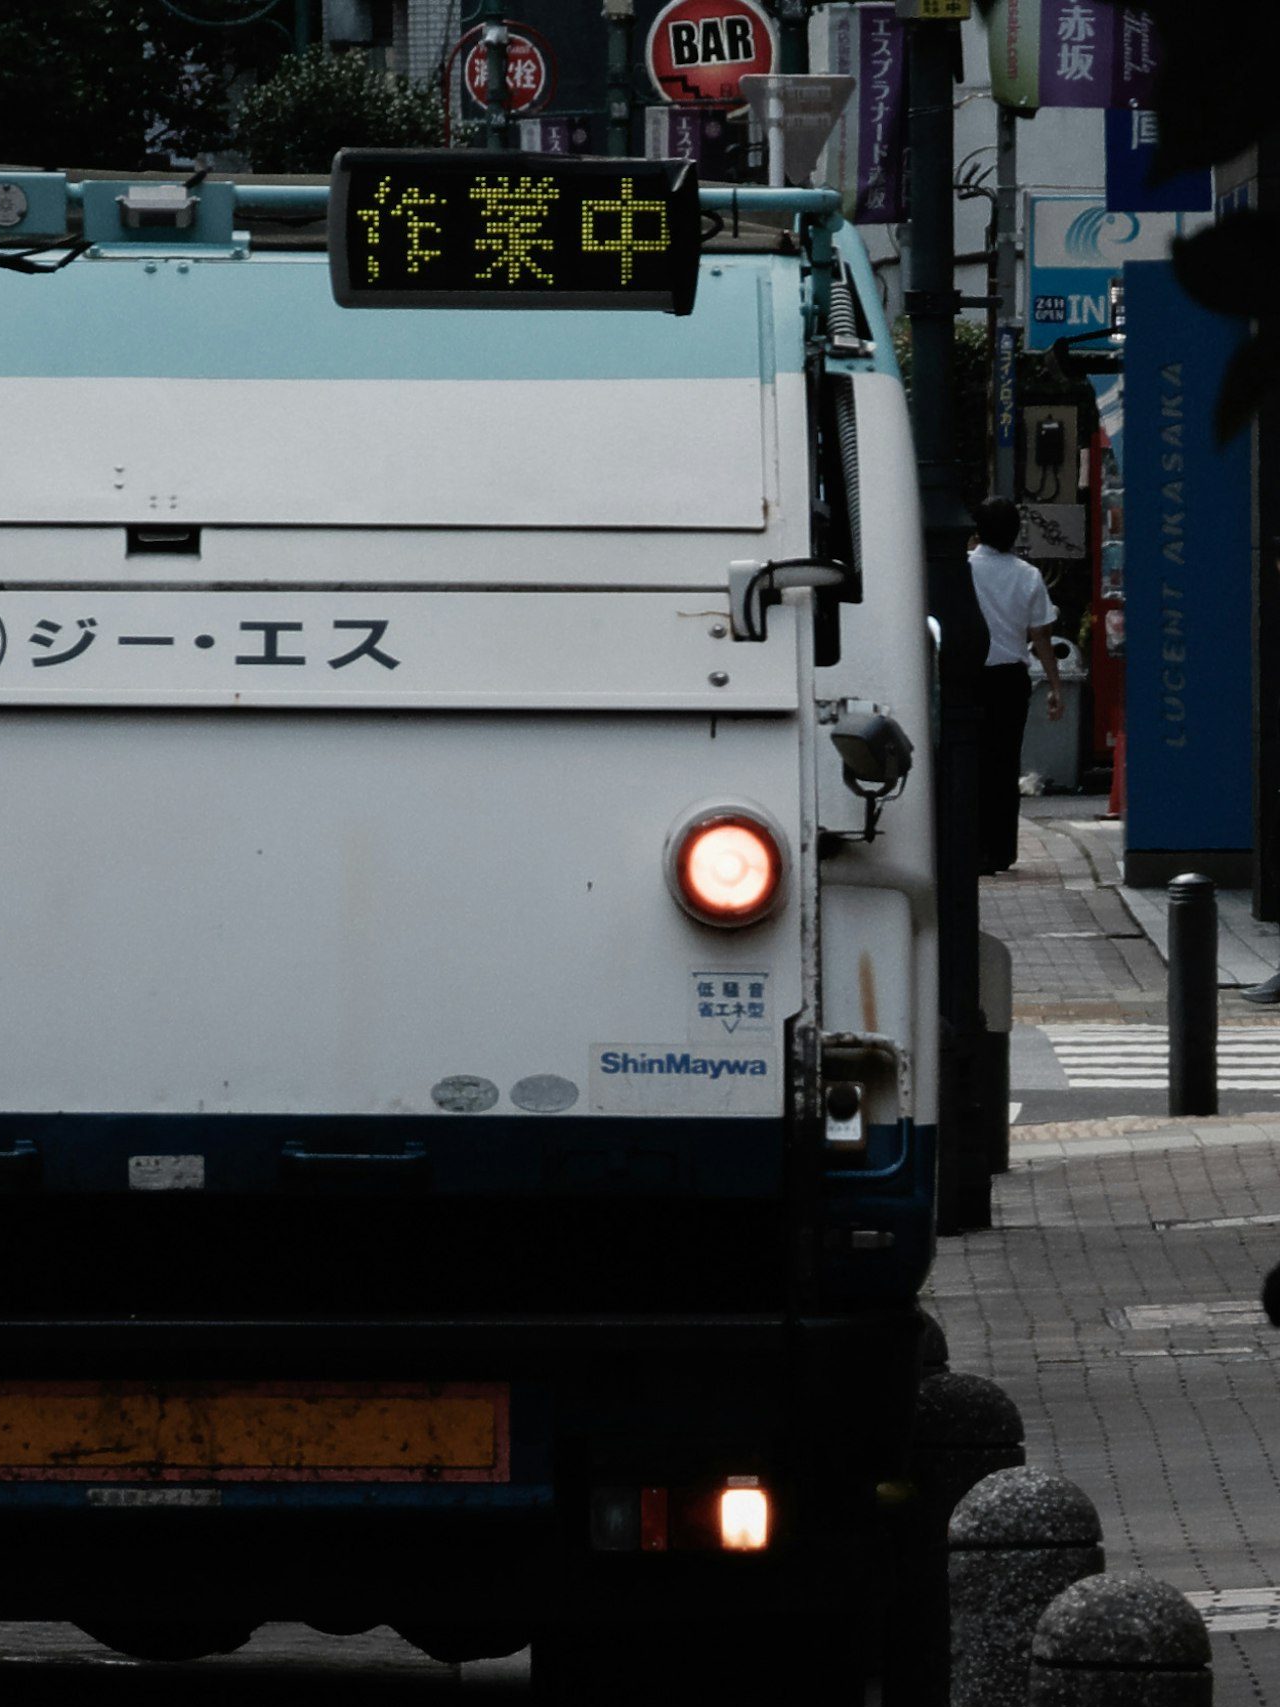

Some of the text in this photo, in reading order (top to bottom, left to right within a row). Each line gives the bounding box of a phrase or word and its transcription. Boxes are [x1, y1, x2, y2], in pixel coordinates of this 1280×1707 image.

[670, 17, 755, 68] BAR
[1056, 5, 1096, 82] 赤坂
[474, 58, 537, 90] 消栓
[866, 18, 894, 209] エスプラナード赤坂
[357, 176, 671, 285] 作業中
[1067, 294, 1106, 325] IN
[1160, 361, 1187, 749] LUCENT AKASAKA
[697, 981, 765, 998] 低騒音
[698, 1002, 765, 1018] 省エネ型
[600, 1051, 768, 1079] ShinMaywa
